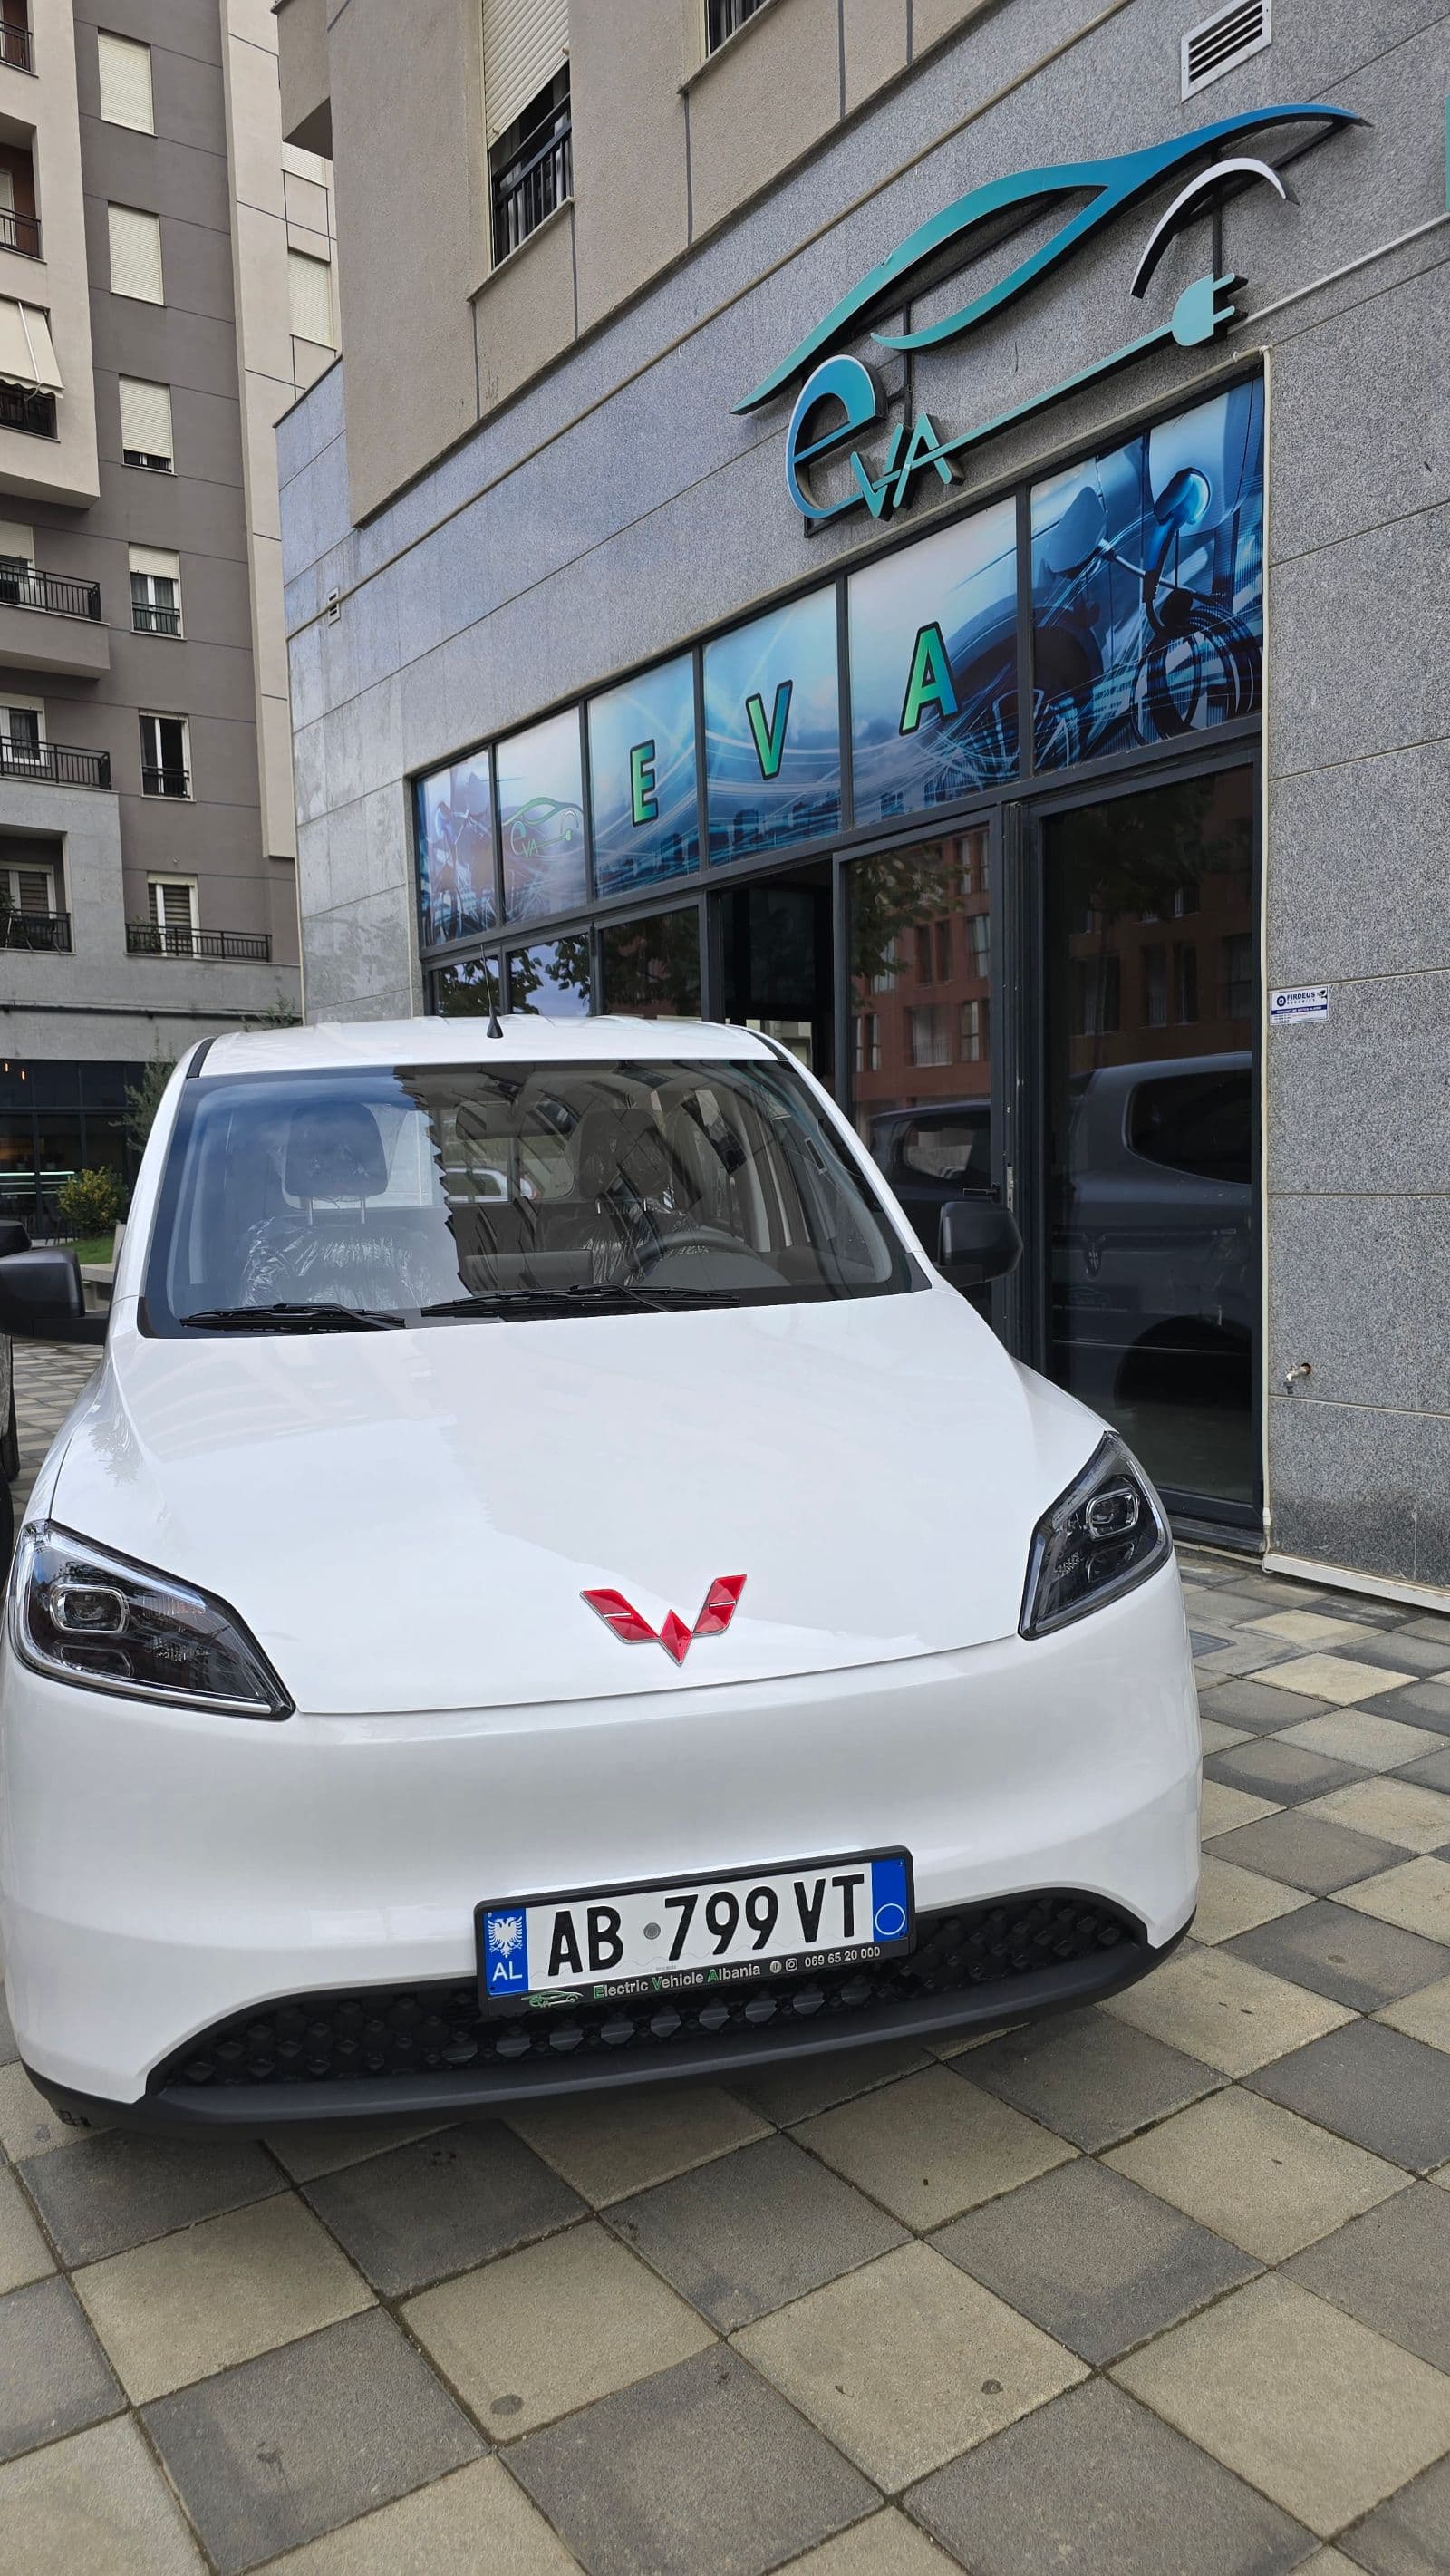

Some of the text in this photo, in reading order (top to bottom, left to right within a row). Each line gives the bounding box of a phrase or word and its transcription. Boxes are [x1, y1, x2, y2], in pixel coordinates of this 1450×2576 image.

[1287, 992, 1316, 1001] FIRDEUS
[548, 1873, 865, 1977] AB 799 VT
[492, 1961, 523, 1982] AL
[594, 1946, 881, 2000] Electric Vehicle Albania 069 65 20 000
